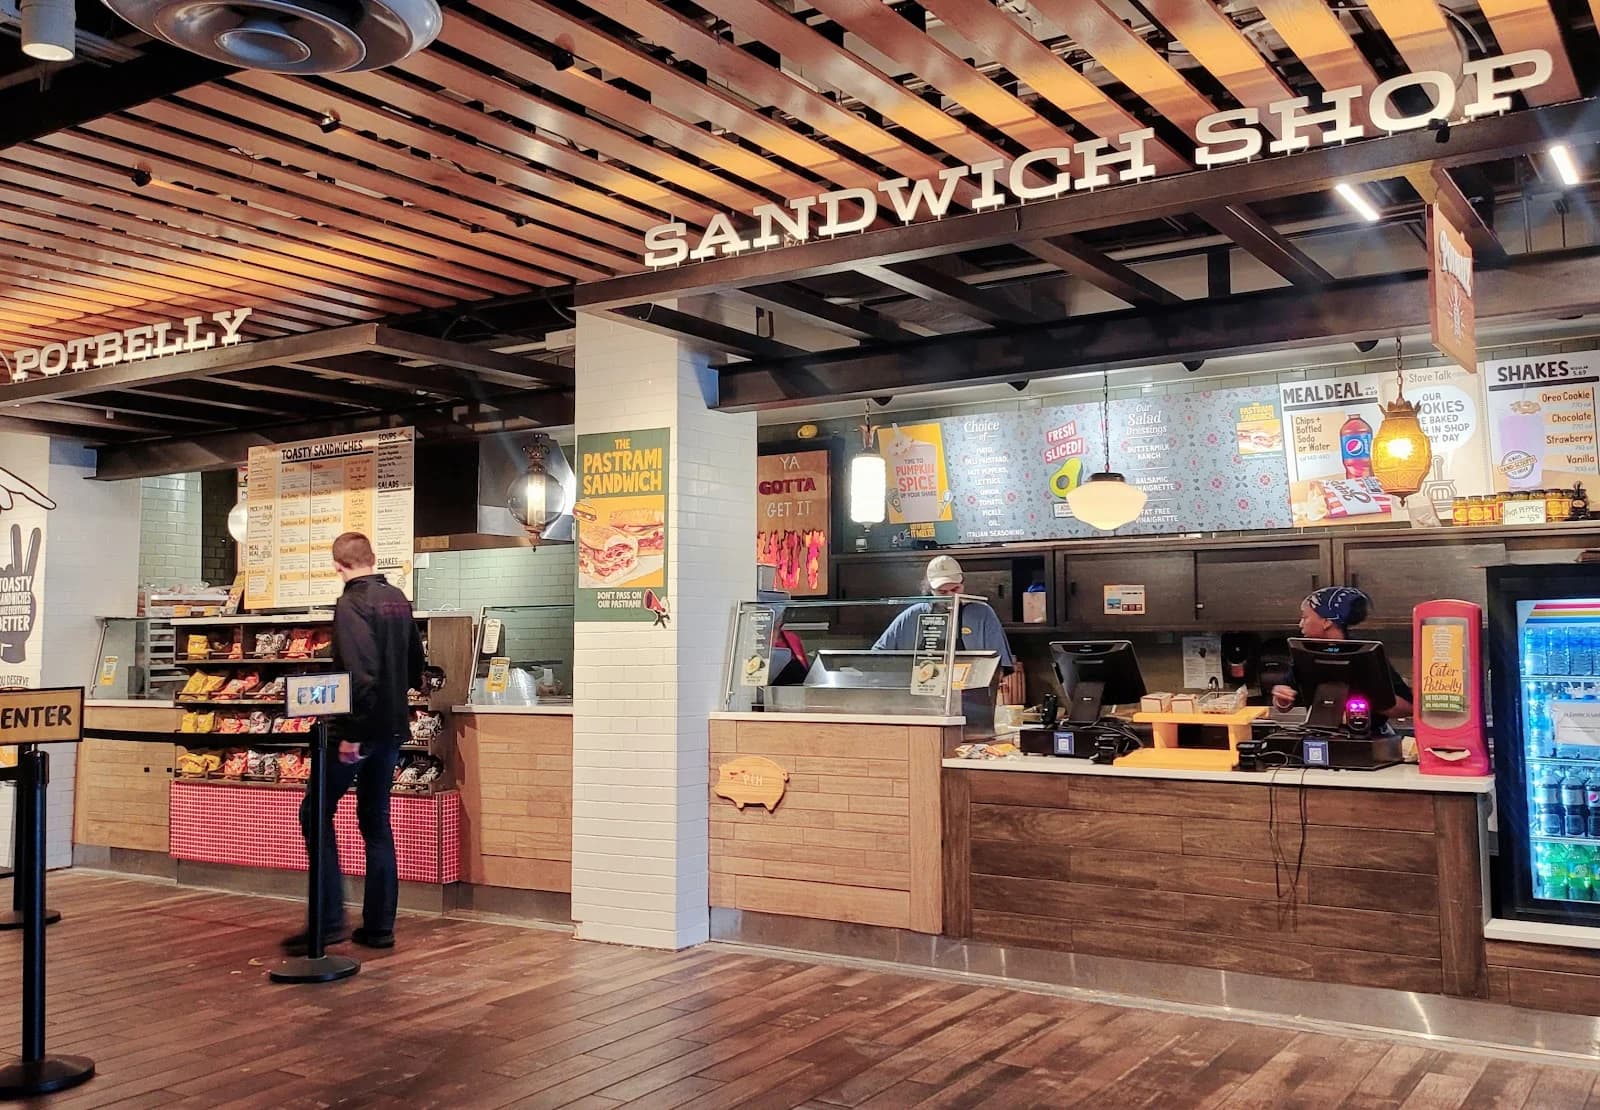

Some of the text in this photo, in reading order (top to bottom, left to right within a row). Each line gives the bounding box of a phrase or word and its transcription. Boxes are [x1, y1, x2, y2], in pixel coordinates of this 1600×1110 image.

[645, 48, 1553, 268] SANDWICH SHOP
[12, 307, 252, 382] POTBELLY
[1409, 370, 1452, 383] Stove Talk
[1497, 361, 1569, 382] SHAKES
[1282, 386, 1323, 404] MEAL
[1325, 381, 1363, 400] DEAL
[1422, 393, 1441, 401] OUR
[1542, 391, 1590, 402] Oreo Cookie
[1422, 400, 1465, 415] OKIES
[1128, 410, 1162, 427] Salad
[1296, 417, 1315, 427] Chips
[1430, 414, 1459, 424] BAKED
[1552, 412, 1592, 423] Chocolate
[964, 420, 1000, 433] Choice
[1047, 422, 1075, 443] FRESH
[1296, 424, 1322, 434] Bottled
[1444, 423, 1470, 433] SHOP
[377, 431, 397, 441] SOUPS
[1297, 435, 1315, 443] Soda
[1442, 433, 1460, 442] DAY
[1546, 434, 1593, 445] Strawberry
[281, 440, 363, 461] TOASTY SANDWICHES
[614, 438, 631, 450] THE
[1309, 443, 1331, 451] Water
[583, 448, 663, 474] PASTRAMI
[779, 456, 801, 470] YA
[1566, 455, 1595, 464] Vanilla
[896, 464, 934, 476] PUMPKIN
[377, 480, 399, 490] SALADS
[583, 470, 662, 495] SANDWICH
[758, 477, 817, 495] GOTTA
[898, 475, 936, 492] SPICE
[767, 500, 813, 518] GET IT
[377, 557, 398, 566] SHAKES
[0, 592, 32, 605] ANDWICHES
[616, 591, 631, 600] PASS
[632, 591, 642, 600] ON
[598, 600, 610, 608] OUR
[1429, 662, 1459, 678] Cater
[7, 674, 30, 687] DESERVE
[1423, 675, 1463, 694] Potbelly
[297, 685, 340, 706] EXIT
[1, 705, 73, 729] ENTER
